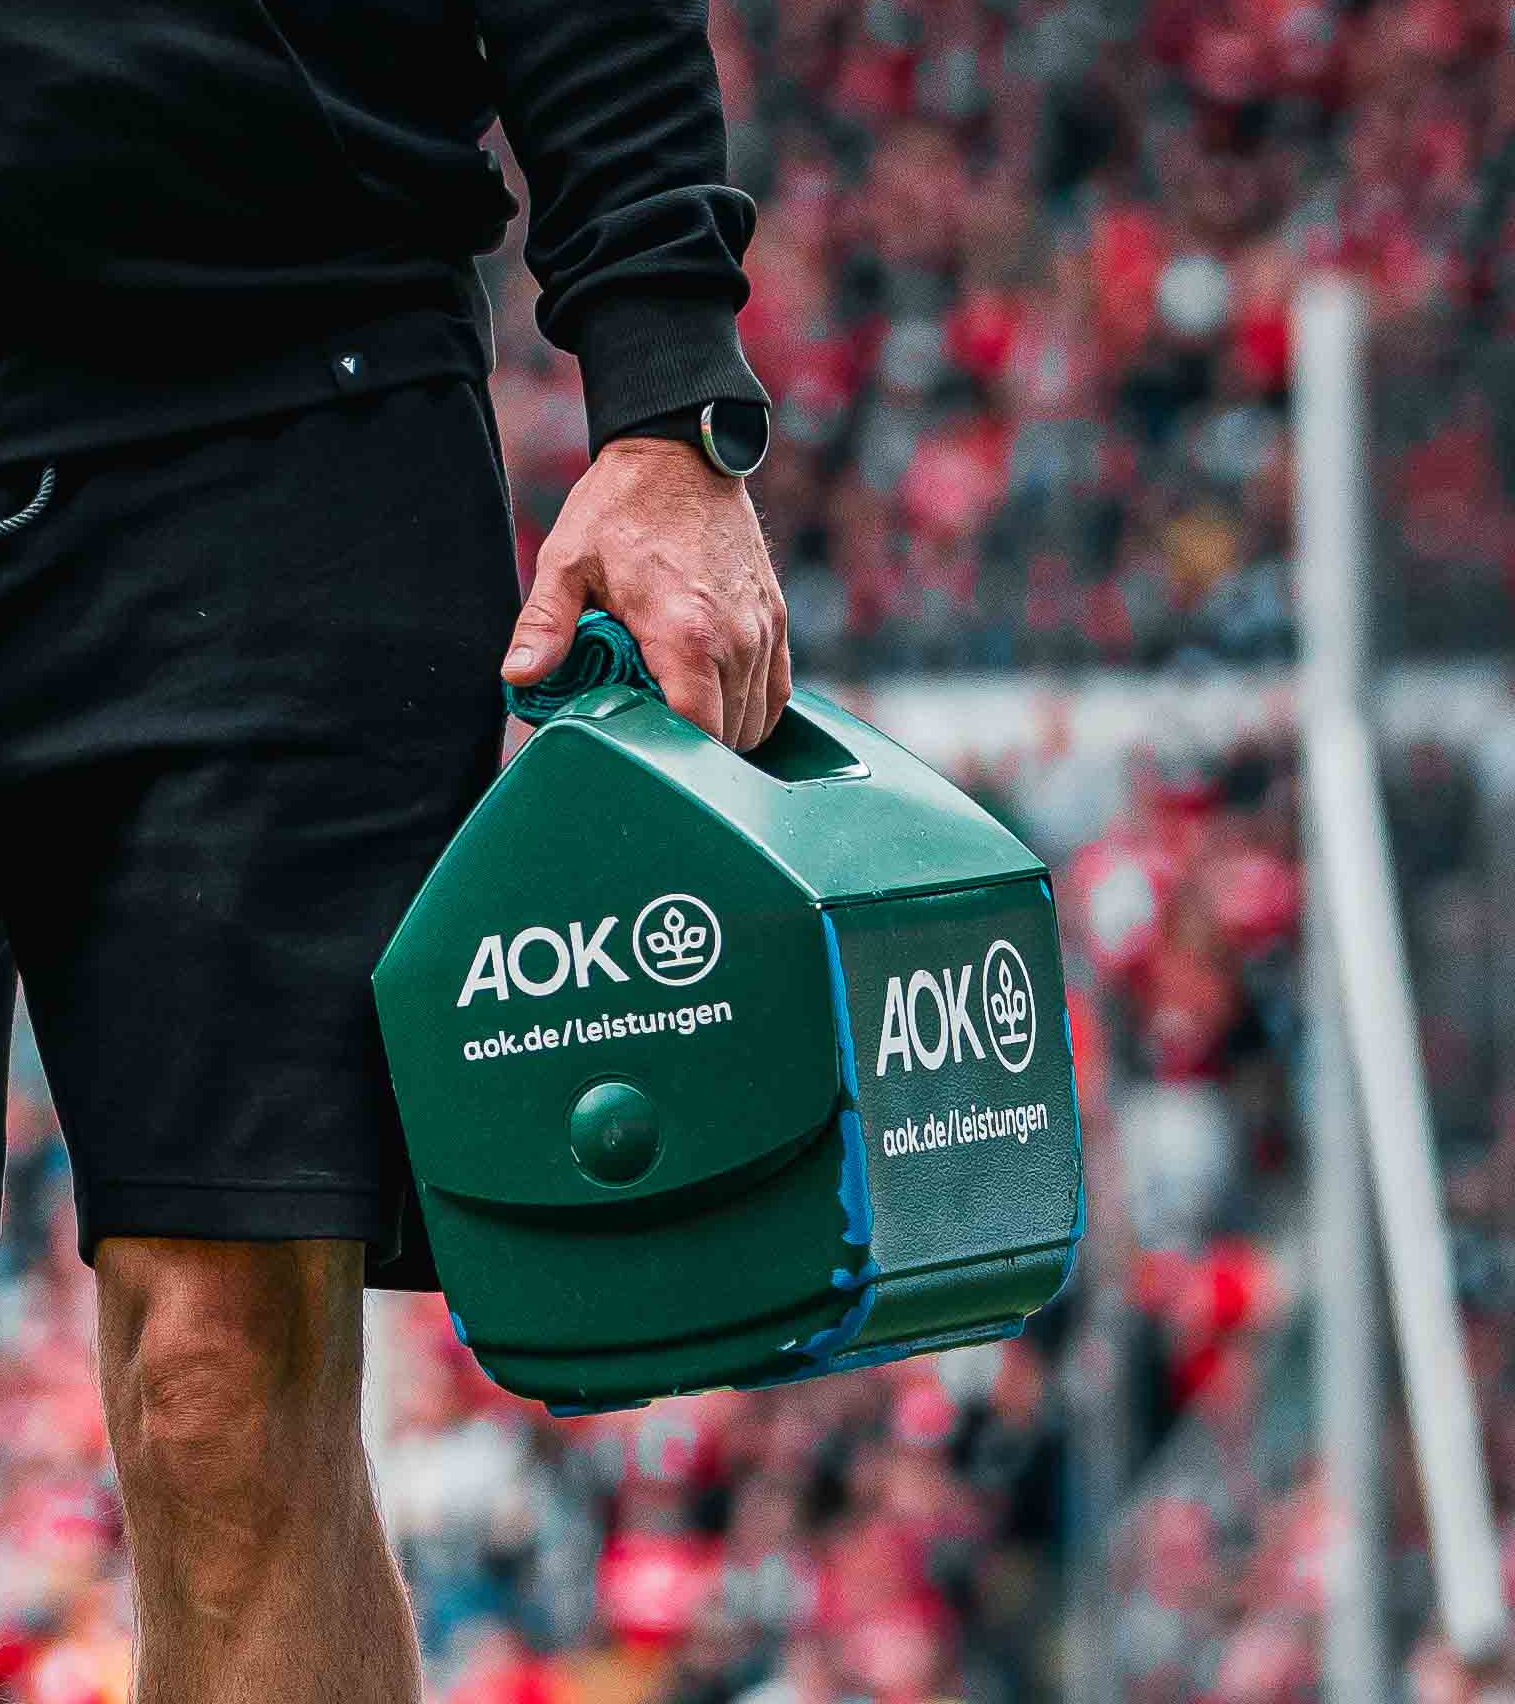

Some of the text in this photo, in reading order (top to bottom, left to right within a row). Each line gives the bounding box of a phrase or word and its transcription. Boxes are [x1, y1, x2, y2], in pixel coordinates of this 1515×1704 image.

[456, 916, 631, 1007] AOK
[463, 1001, 733, 1061] aok.de/leistungen
[875, 964, 986, 1077] AOK
[883, 1103, 1050, 1157] aok.de/leistungen
